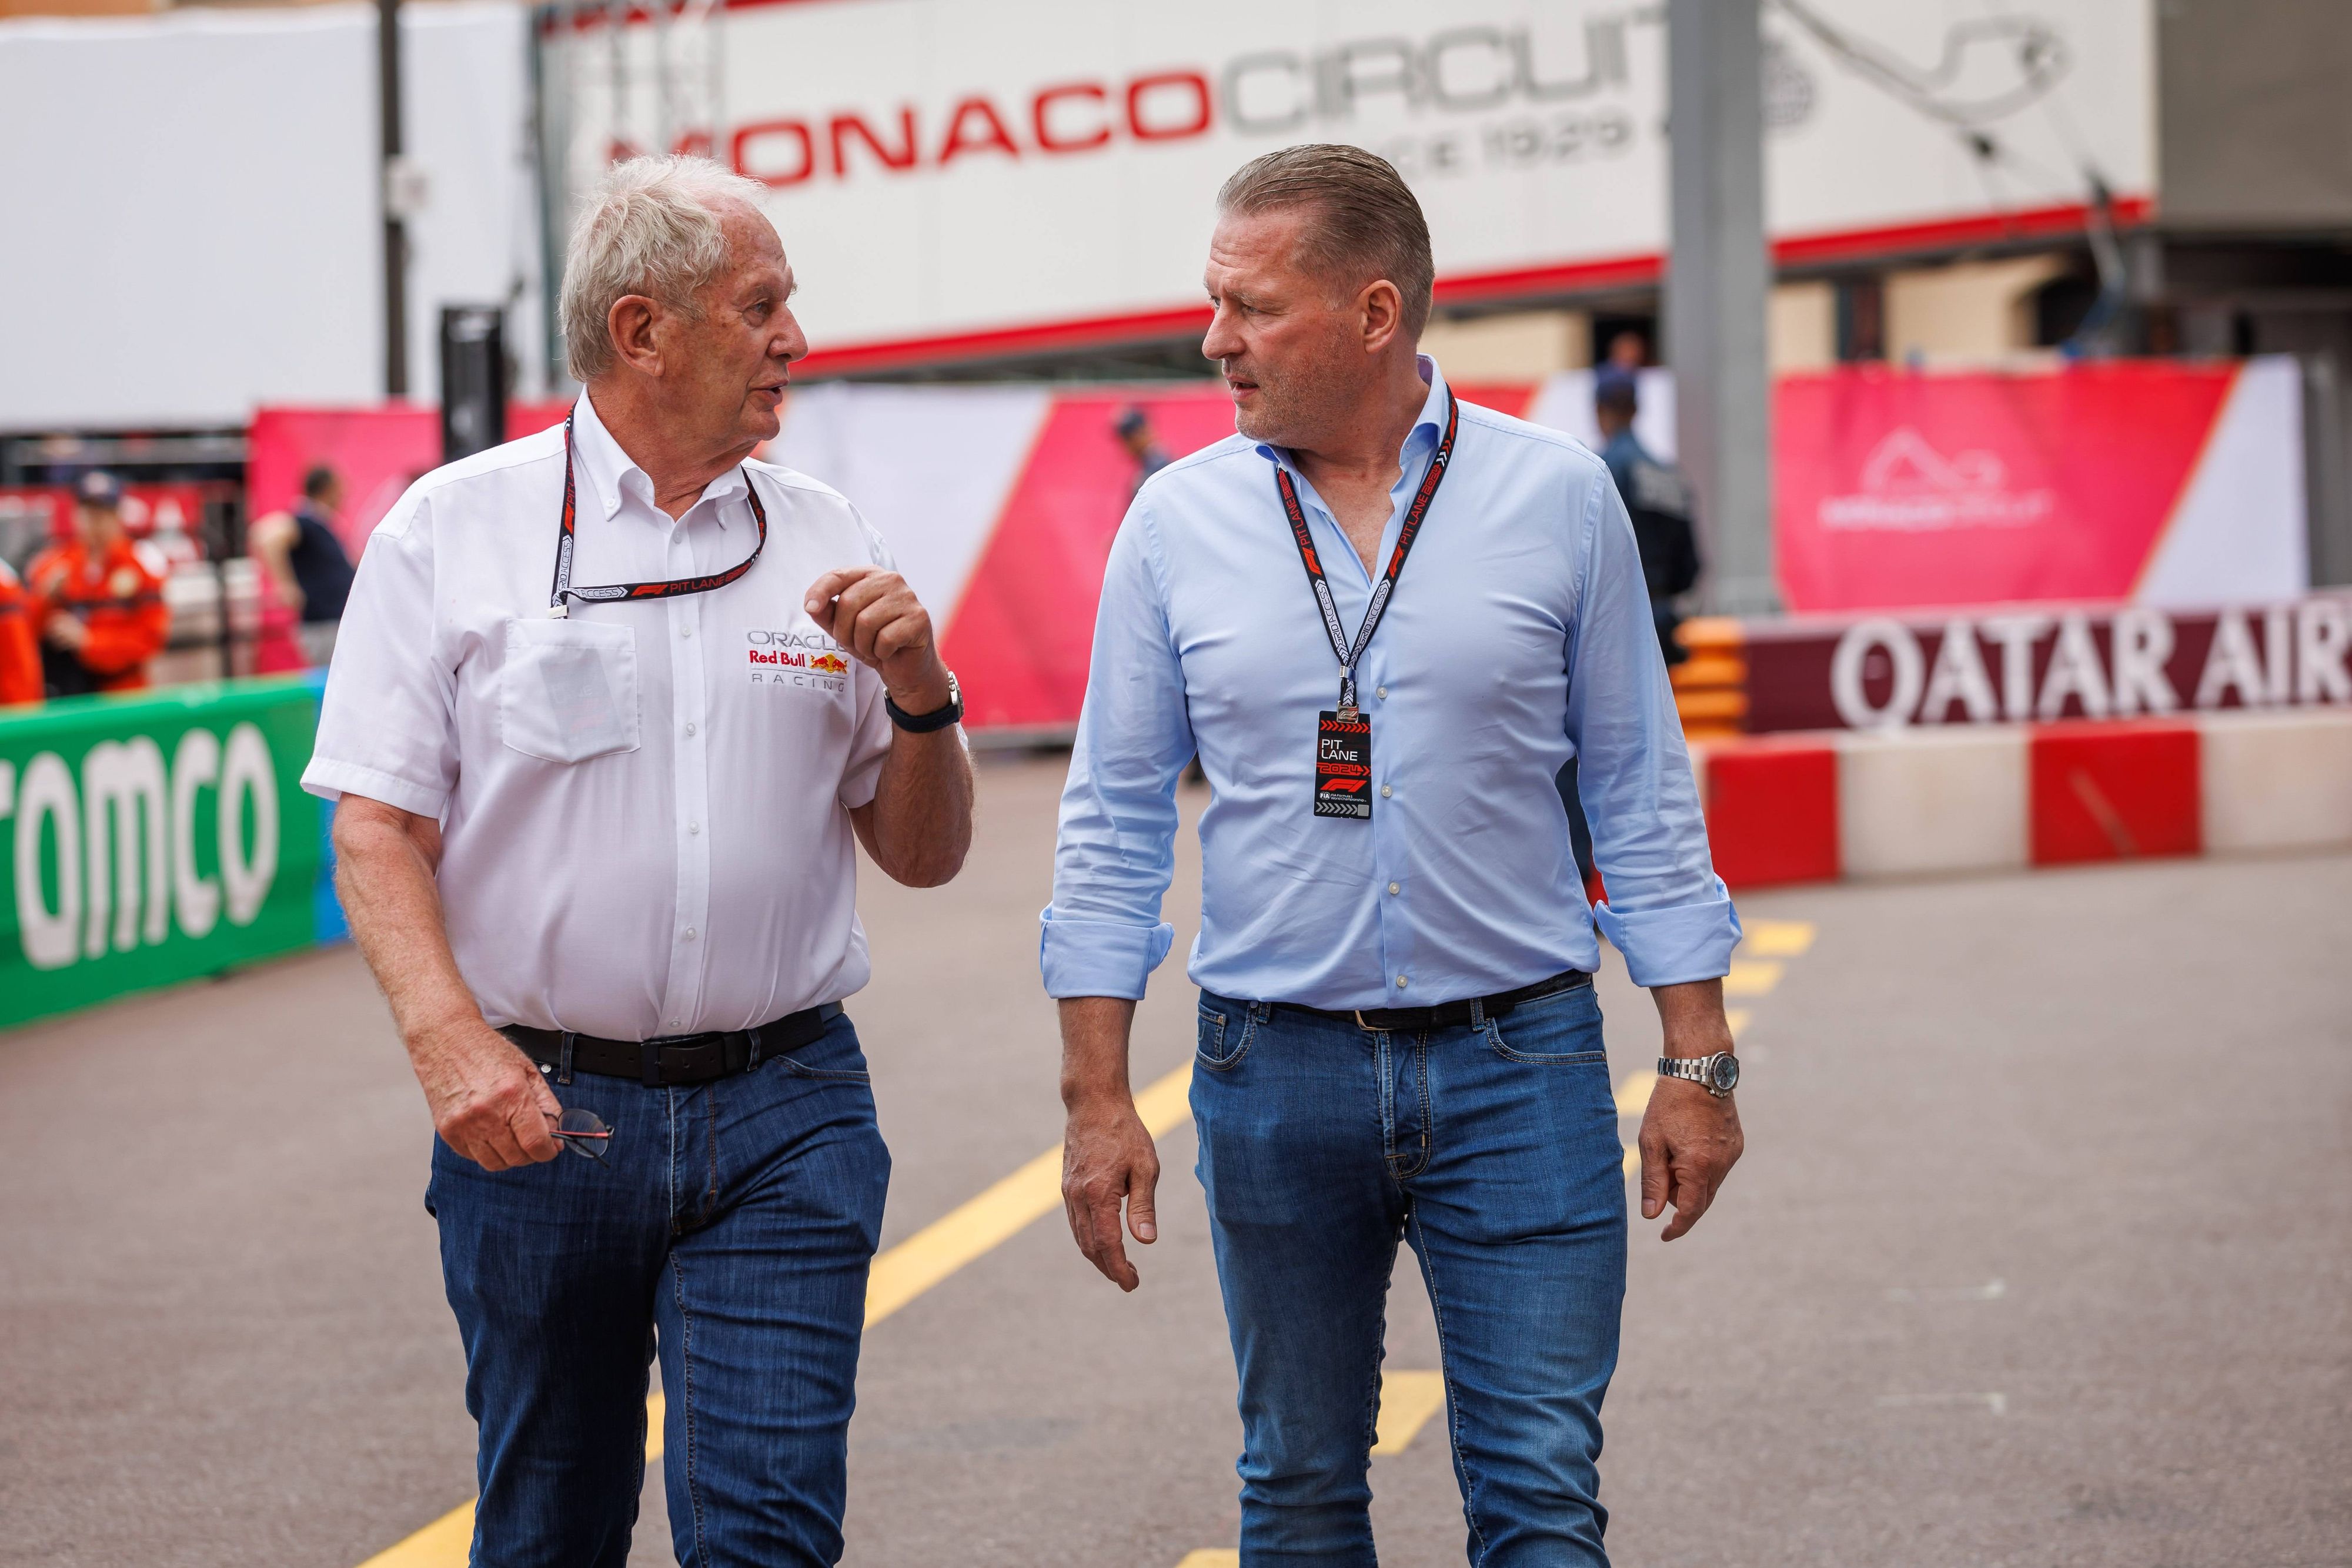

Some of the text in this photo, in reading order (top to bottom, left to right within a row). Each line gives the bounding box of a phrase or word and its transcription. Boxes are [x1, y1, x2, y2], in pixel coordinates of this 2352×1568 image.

[566, 485, 575, 504] PIT
[1399, 525, 1414, 544] PIT
[1408, 494, 1428, 526] LANE
[1421, 464, 1442, 496] 2024
[1287, 498, 1304, 529] LANE
[1297, 529, 1311, 546] PIT
[560, 542, 572, 573] ACCESS
[580, 587, 619, 598] ACCESS
[670, 581, 690, 593] PIT
[691, 576, 725, 590] LANE
[1318, 586, 1344, 645] GRID ACCESS
[1359, 587, 1388, 645] GRID ACCESS
[749, 650, 806, 667] Red Bull
[1830, 600, 2352, 731] QATAR AIR
[752, 674, 844, 692] RACING
[1321, 738, 1343, 750] PIT
[1321, 749, 1358, 761] LANE
[1319, 764, 1361, 775] 2024
[0, 722, 280, 970] amco
